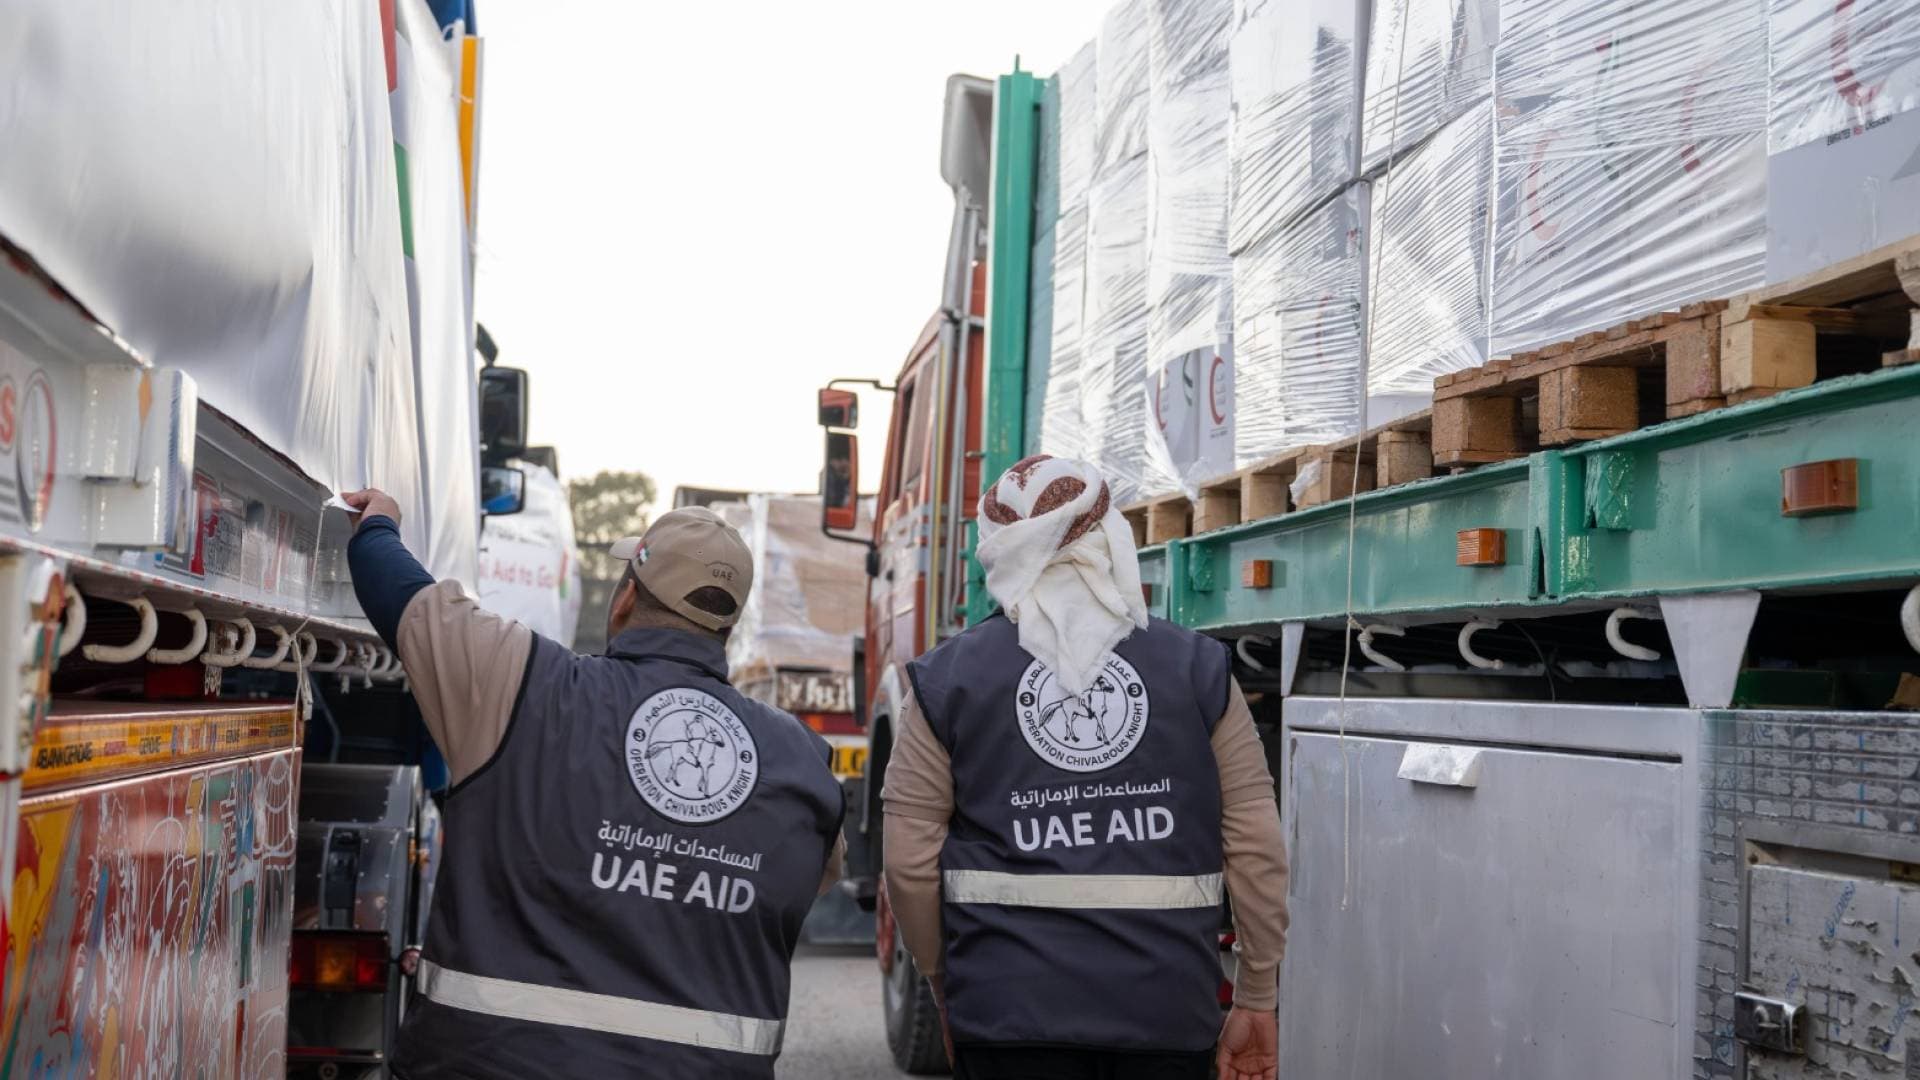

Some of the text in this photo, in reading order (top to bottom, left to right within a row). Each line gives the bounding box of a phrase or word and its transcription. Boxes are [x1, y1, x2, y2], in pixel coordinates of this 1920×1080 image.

[712, 569, 733, 581] UAE
[644, 692, 747, 745] عملية الفارس الشهم
[1023, 702, 1144, 767] OPERATION CHIVALROUS KNIGHT
[630, 748, 753, 817] OPERATION CHIVALROUS KNIGHT
[1010, 777, 1172, 809] المساعدات الإماراتية
[597, 818, 763, 872] المساعدات الإماراتية
[1013, 806, 1175, 852] UAE AID
[590, 852, 756, 914] UAE AID
